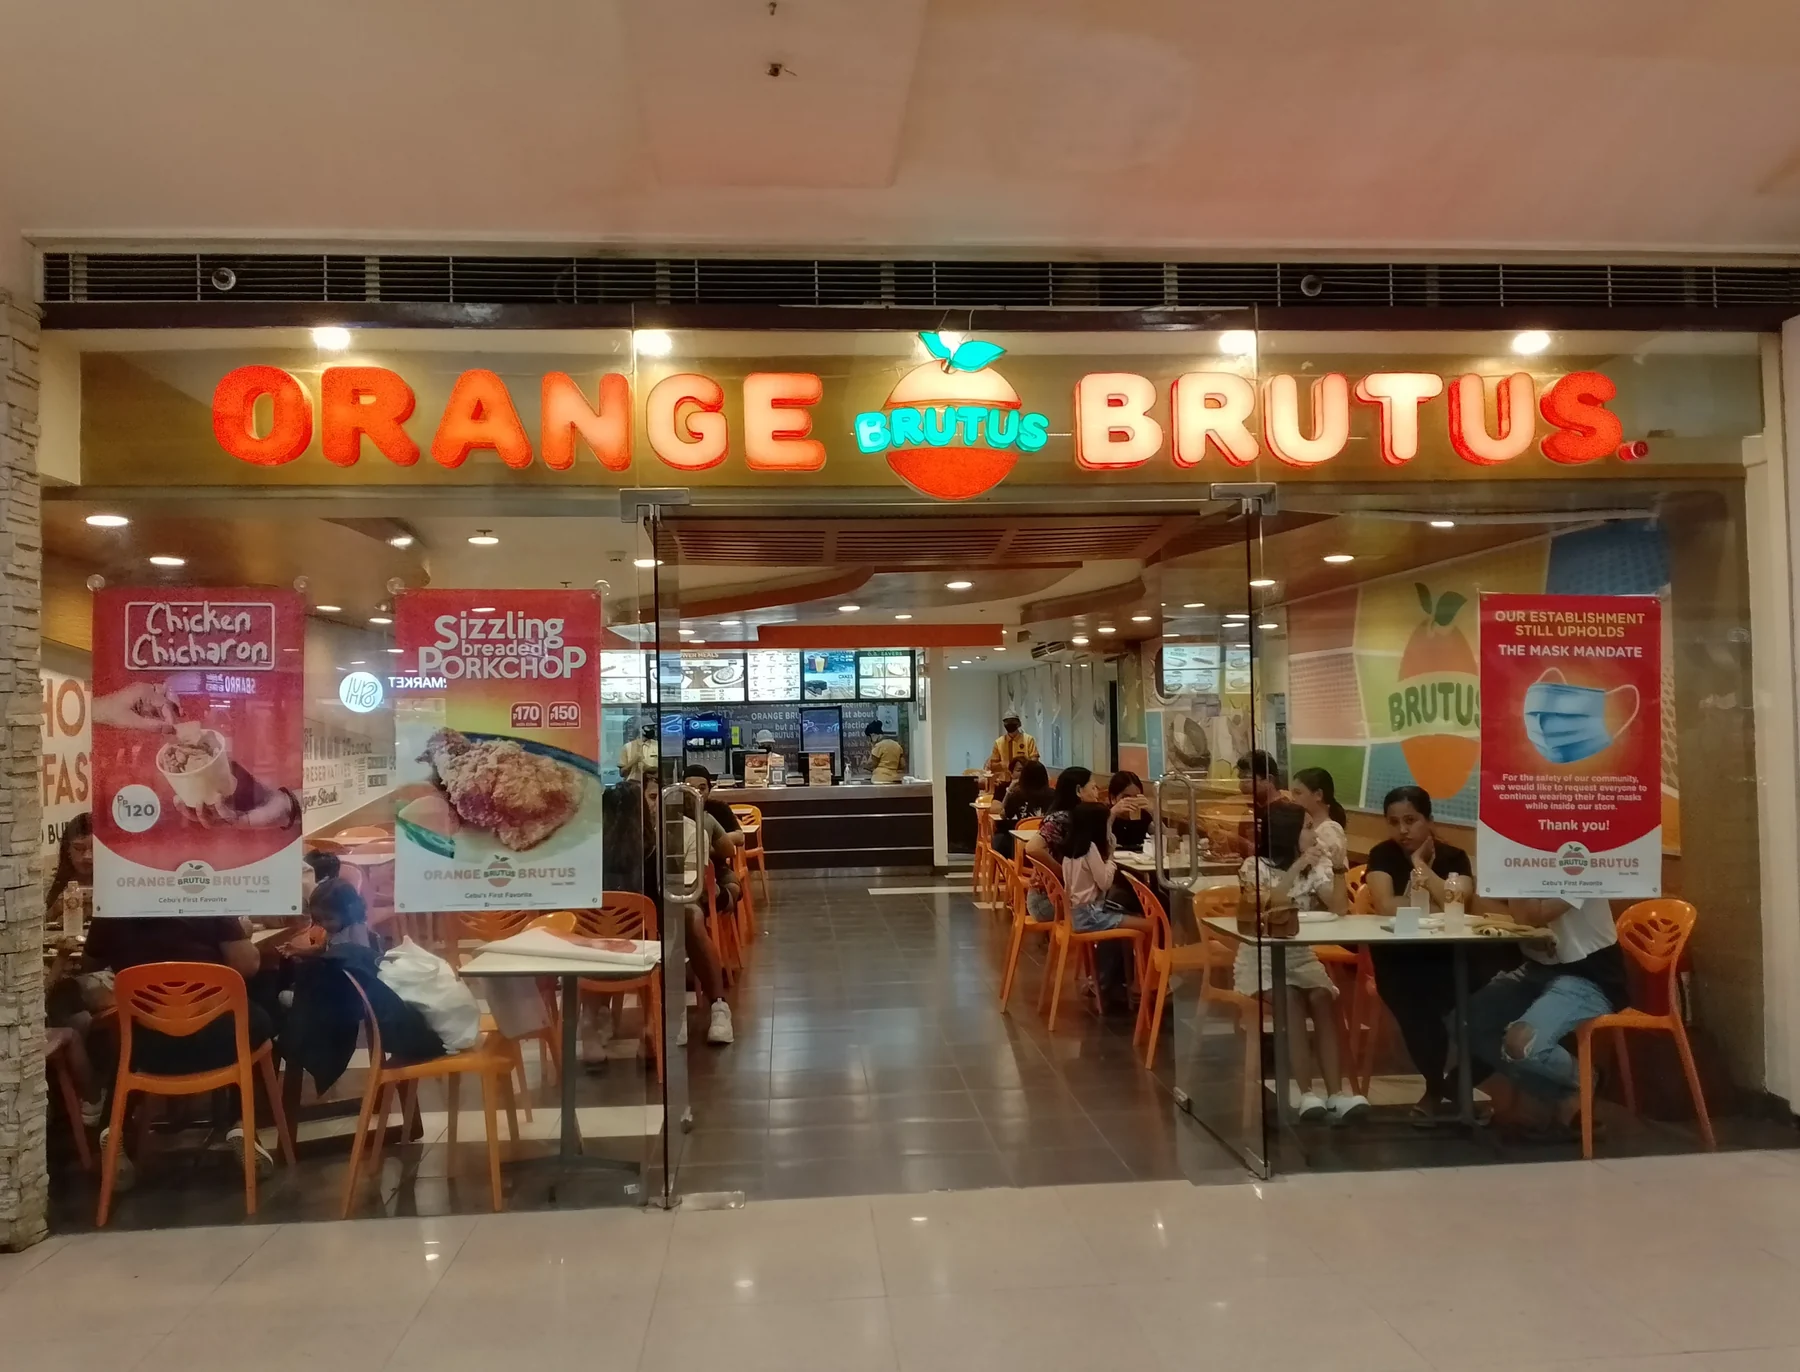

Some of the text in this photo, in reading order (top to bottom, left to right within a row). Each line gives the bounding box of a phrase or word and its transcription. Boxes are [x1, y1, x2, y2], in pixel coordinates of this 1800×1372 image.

[212, 363, 827, 472] ORANGE
[1075, 371, 1624, 469] BRUTUS
[854, 406, 1050, 454] BRUTUS
[146, 600, 252, 634] Chicken
[1495, 610, 1646, 624] OUR ESTABLISHMENT
[434, 610, 565, 651] Sizzling
[1515, 625, 1625, 638] STILL UPHOLDS
[132, 633, 268, 667] Chicharon
[461, 639, 543, 656] breaded
[1498, 644, 1643, 658] THE MASK MANDATE
[418, 646, 587, 679] PORKCHOP
[42, 678, 93, 738] HO
[853, 709, 874, 718] about
[751, 712, 784, 721] ORANGE
[785, 711, 799, 720] BRU
[775, 722, 788, 731] but
[42, 752, 93, 807] FAS
[1502, 774, 1639, 784] For the safety of our community,
[318, 785, 338, 806] Steak
[1565, 785, 1598, 794] request
[1600, 785, 1637, 794] everyone
[1539, 793, 1573, 802] wearing
[1575, 793, 1595, 801] their
[1597, 793, 1615, 801] face
[1617, 793, 1642, 801] masks
[1525, 802, 1549, 810] while
[1550, 802, 1576, 810] inside
[1594, 803, 1618, 811] store.
[1538, 819, 1610, 832] Thank you!
[1504, 857, 1639, 868] ORANGE BRUTUS BRUTUS
[424, 867, 576, 881] ORANGE BRUTUS BRUTUS
[116, 875, 270, 888] ORANGE BRUTUS BRUTUS
[158, 896, 181, 904] Cebu's
[464, 891, 487, 899] Cebu's
[489, 891, 504, 899] First
